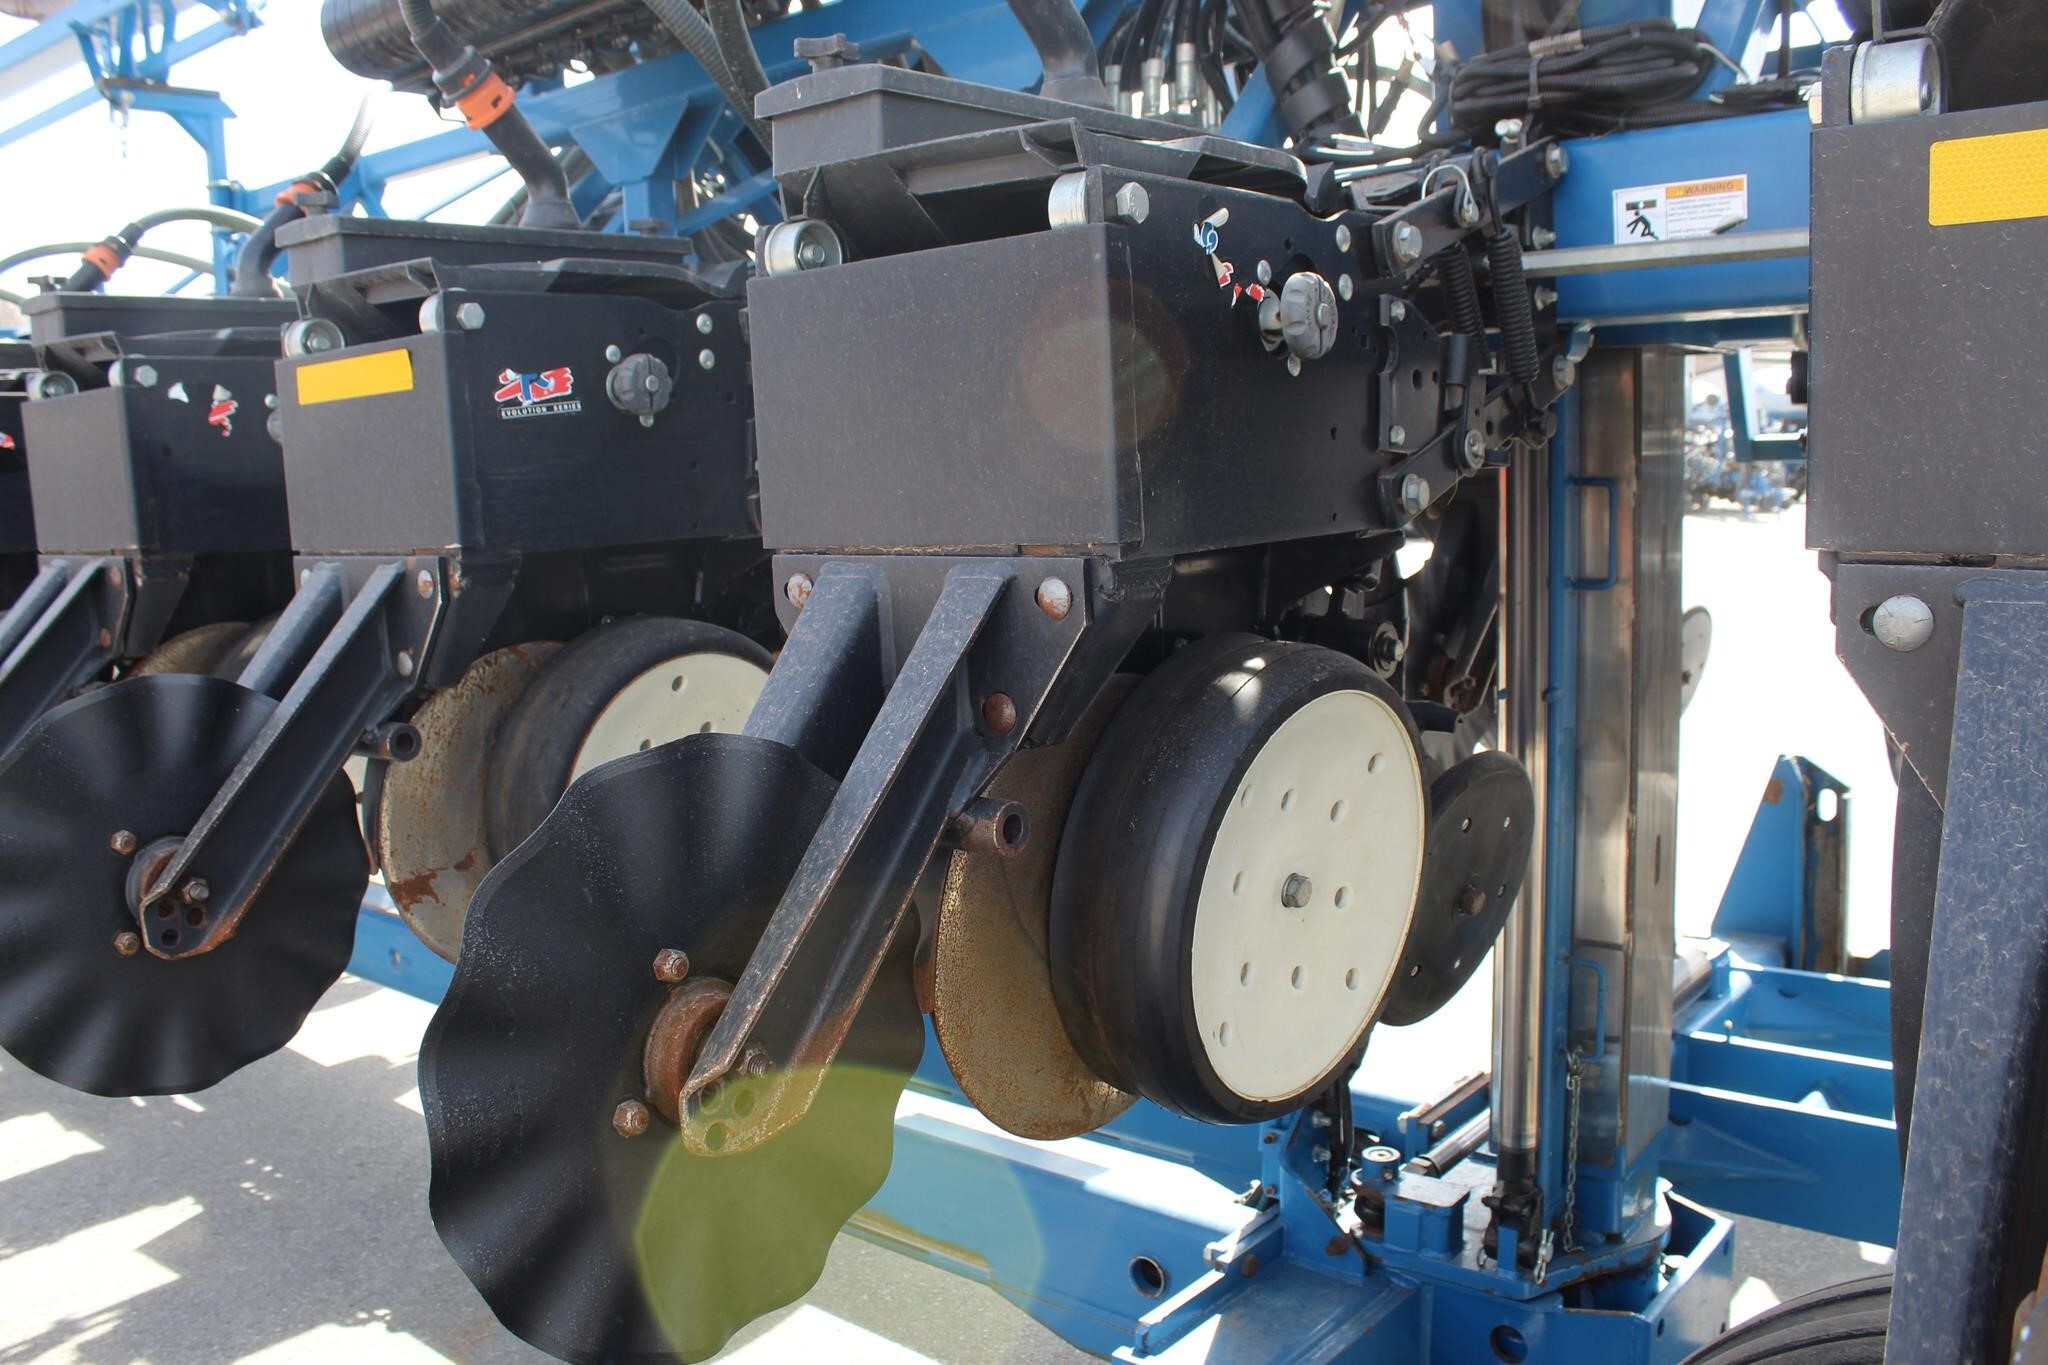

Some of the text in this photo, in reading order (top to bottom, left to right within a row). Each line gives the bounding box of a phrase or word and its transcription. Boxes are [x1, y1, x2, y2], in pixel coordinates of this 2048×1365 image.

[1684, 181, 1735, 195] WARNING
[501, 403, 582, 417] EVOLUTION SERIES
